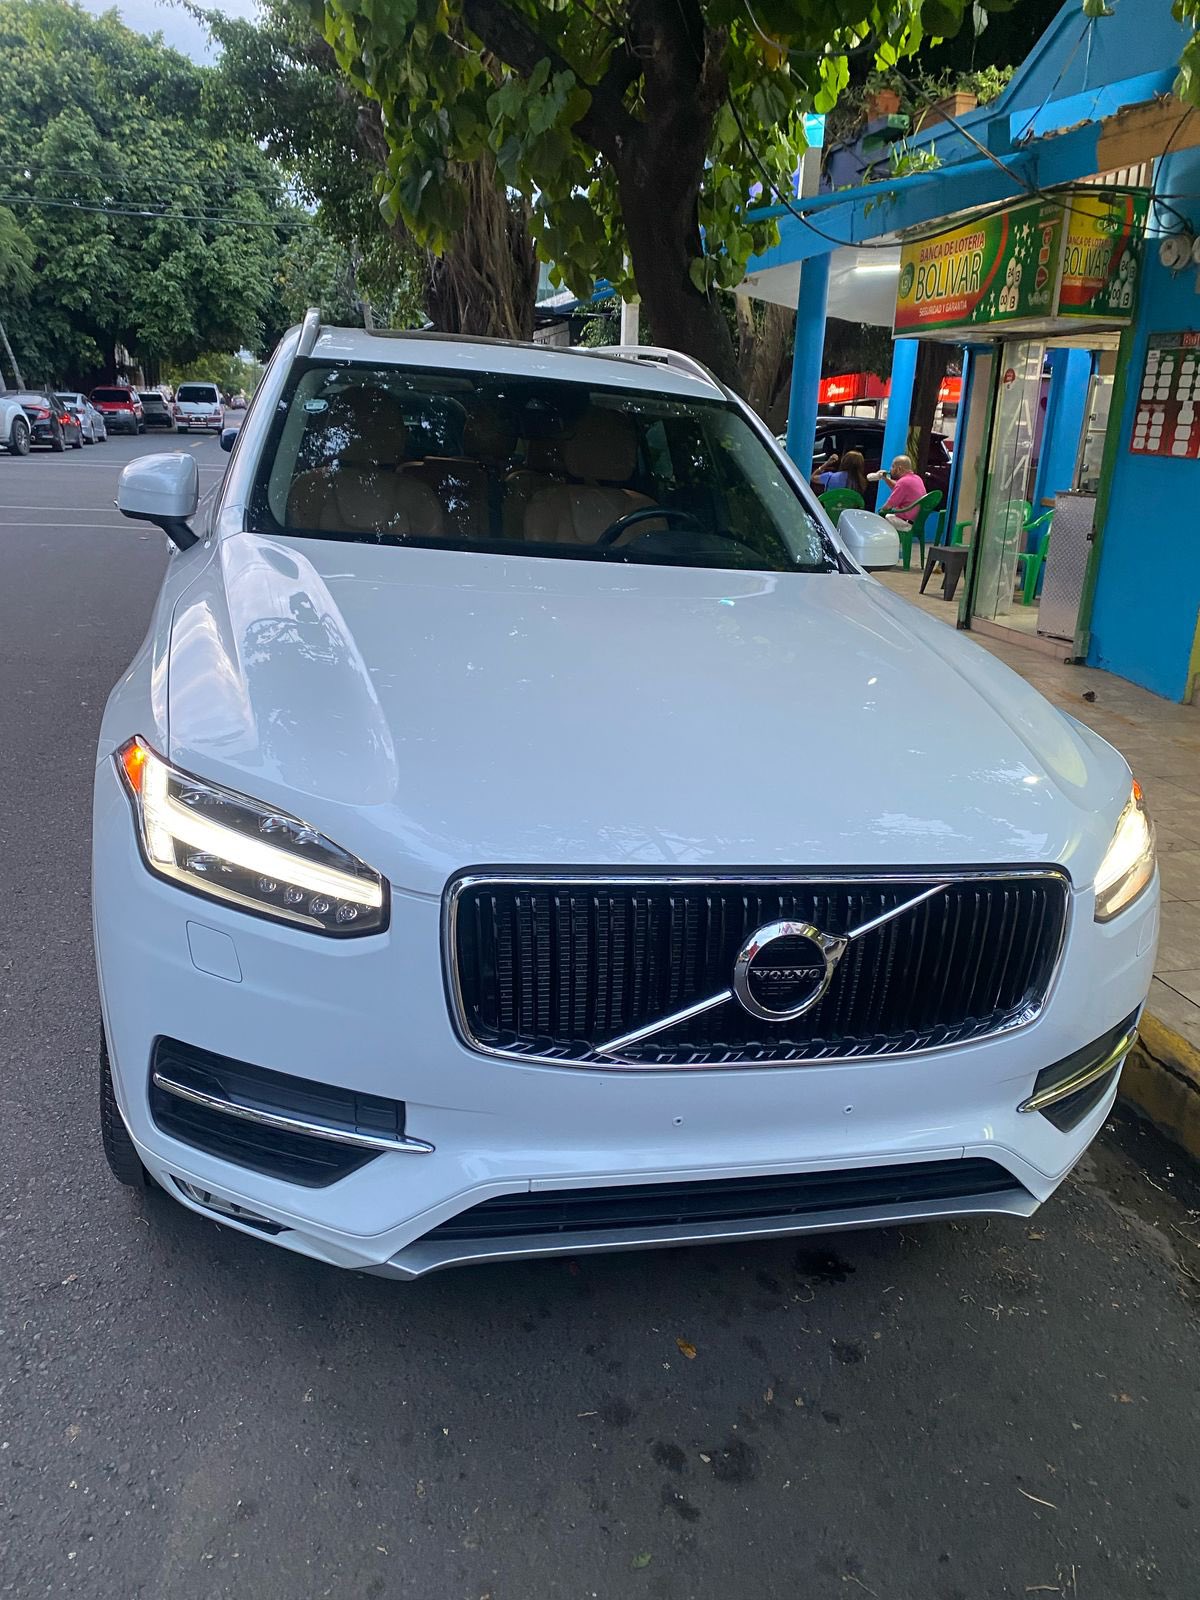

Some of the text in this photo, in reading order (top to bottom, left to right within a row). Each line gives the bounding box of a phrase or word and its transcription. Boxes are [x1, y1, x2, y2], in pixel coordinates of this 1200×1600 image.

[920, 231, 985, 262] BANCA DE LOTERIA
[1063, 246, 1111, 277] BOLIVAR
[915, 251, 983, 304] BOLIVAR
[753, 969, 820, 979] VOLVO
